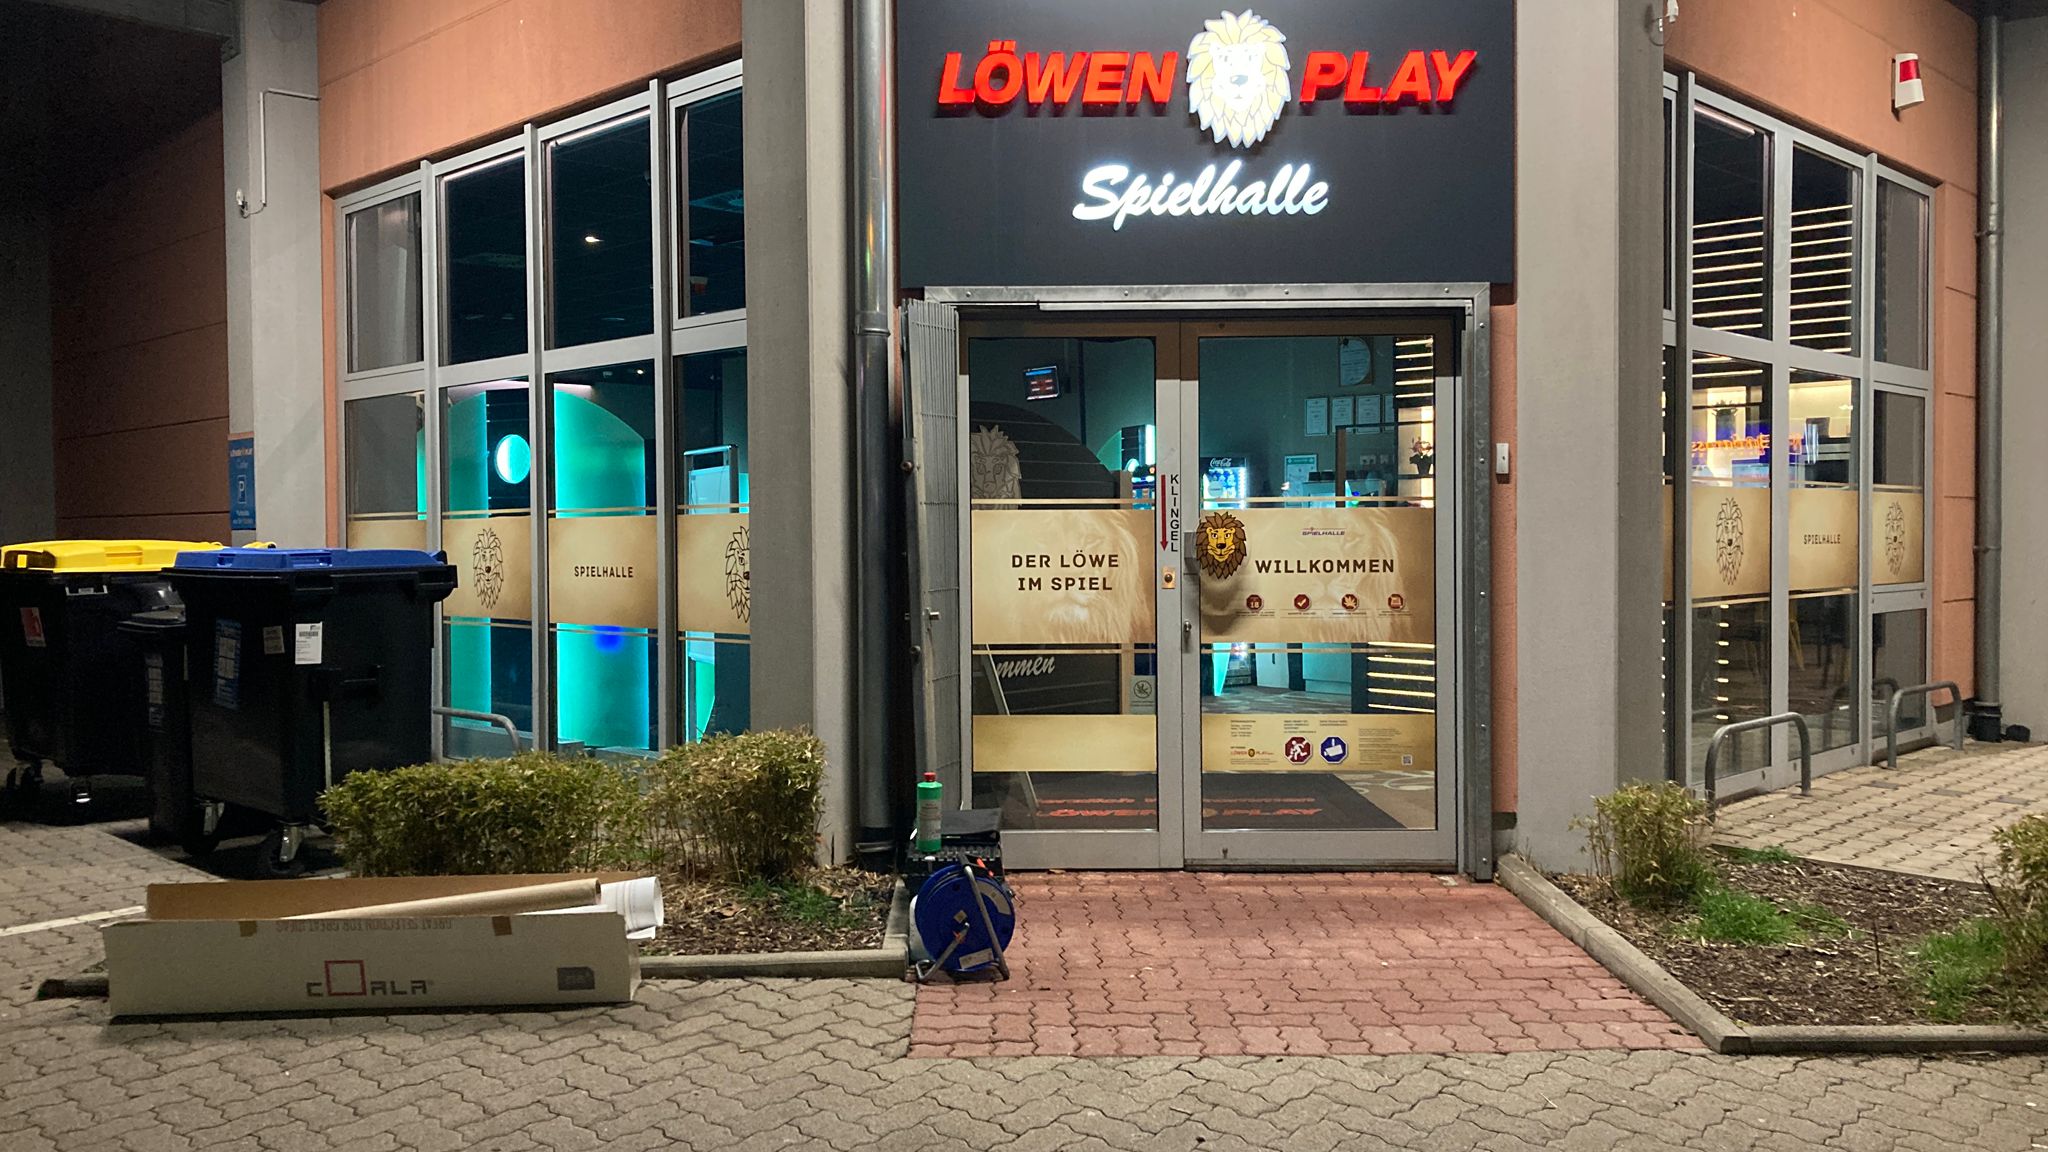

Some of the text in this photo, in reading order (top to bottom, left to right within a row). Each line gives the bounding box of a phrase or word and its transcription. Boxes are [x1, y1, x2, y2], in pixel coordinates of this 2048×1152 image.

[938, 40, 1477, 105] LÖWEN PLAY
[1072, 159, 1329, 231] Spielhalle
[1170, 473, 1180, 553] KLINGEL
[1011, 549, 1119, 568] DER LÖWE
[1255, 559, 1395, 574] WILLKOMMEN
[574, 565, 634, 578] SPIELHALLE
[1017, 577, 1113, 591] IM SPIEL
